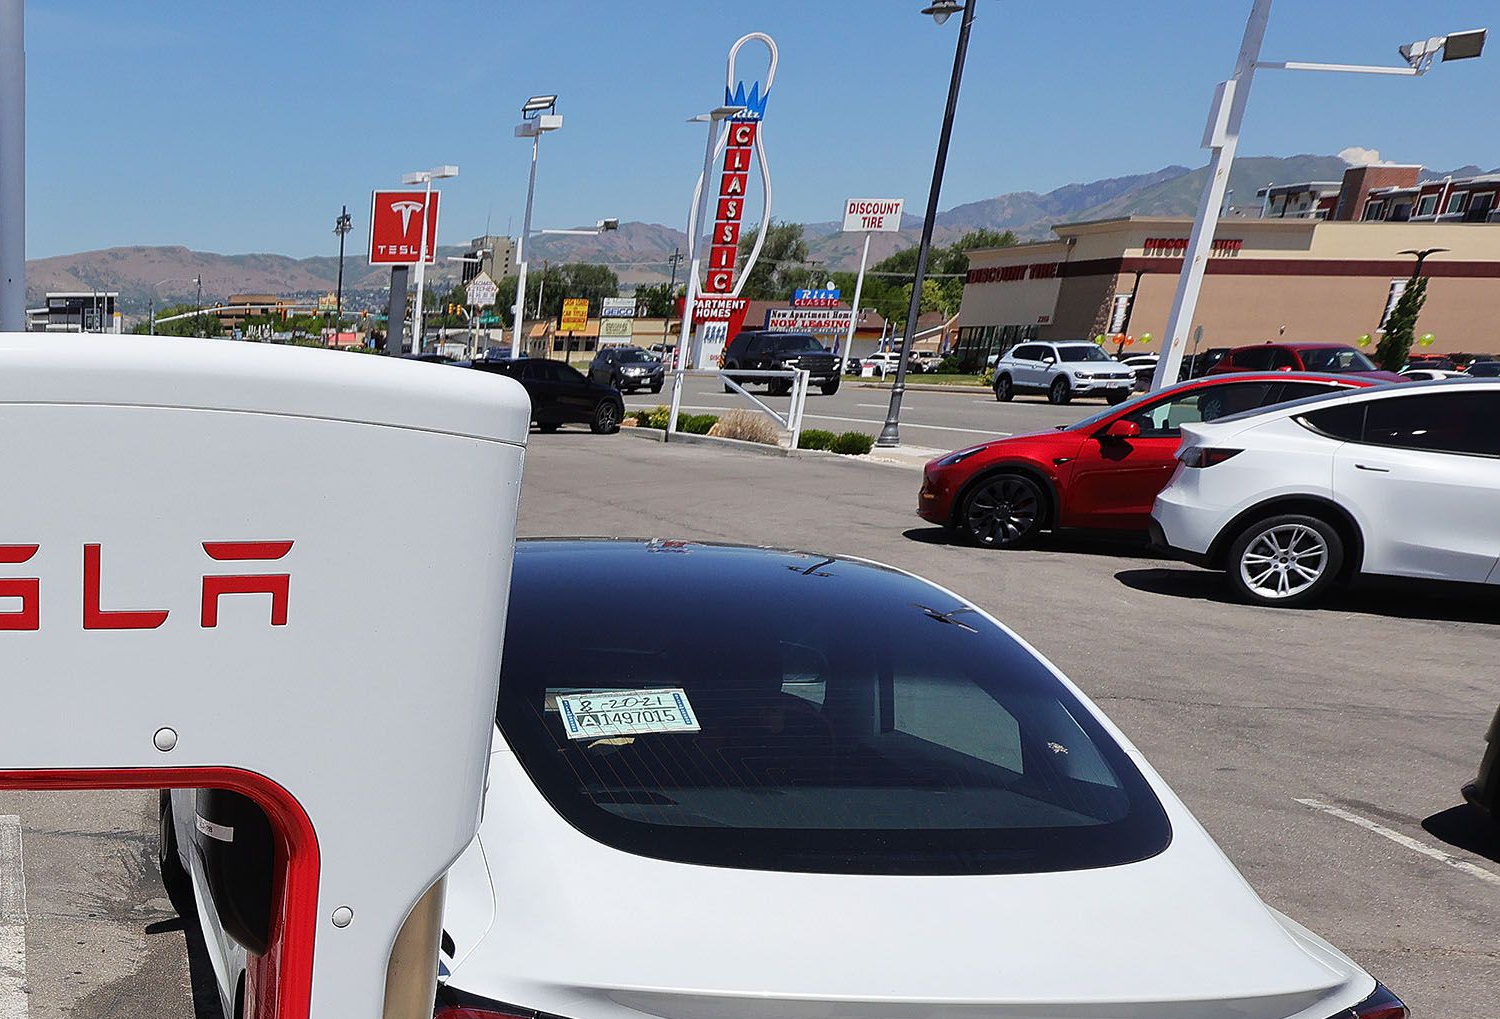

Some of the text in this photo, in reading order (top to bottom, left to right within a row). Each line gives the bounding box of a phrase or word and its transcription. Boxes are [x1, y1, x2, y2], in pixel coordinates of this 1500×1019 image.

[713, 125, 750, 290] CLASSIC
[849, 202, 900, 214] DISCOUNT
[862, 216, 883, 228] TIRE
[802, 289, 835, 299] Ritz
[696, 309, 731, 318] HOMES
[771, 310, 787, 319] New
[789, 310, 830, 320] Apartment
[770, 320, 797, 328] NOW
